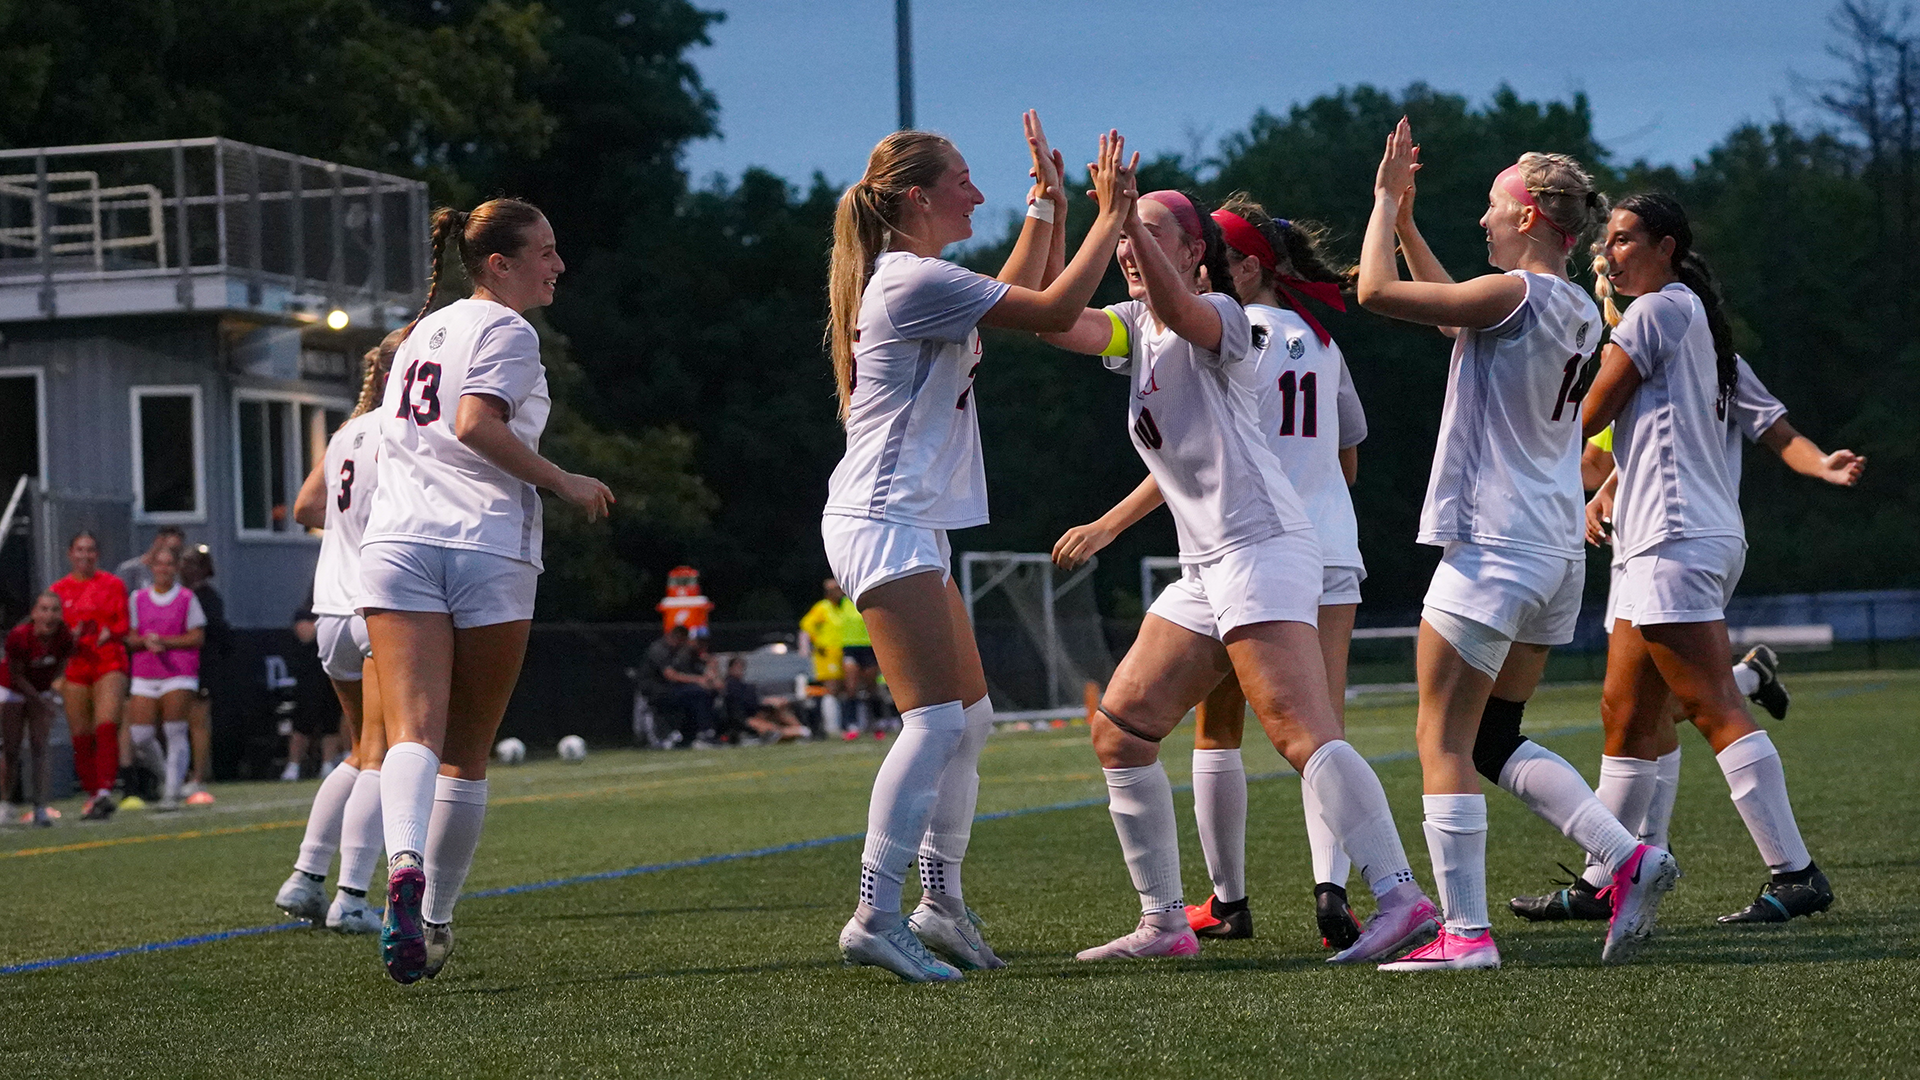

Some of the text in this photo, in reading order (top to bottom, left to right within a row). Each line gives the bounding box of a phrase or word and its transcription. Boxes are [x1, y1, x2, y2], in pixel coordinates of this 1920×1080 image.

[396, 359, 442, 426] 13
[1278, 370, 1317, 437] 11
[1551, 352, 1595, 422] 14
[338, 459, 354, 513] 3
